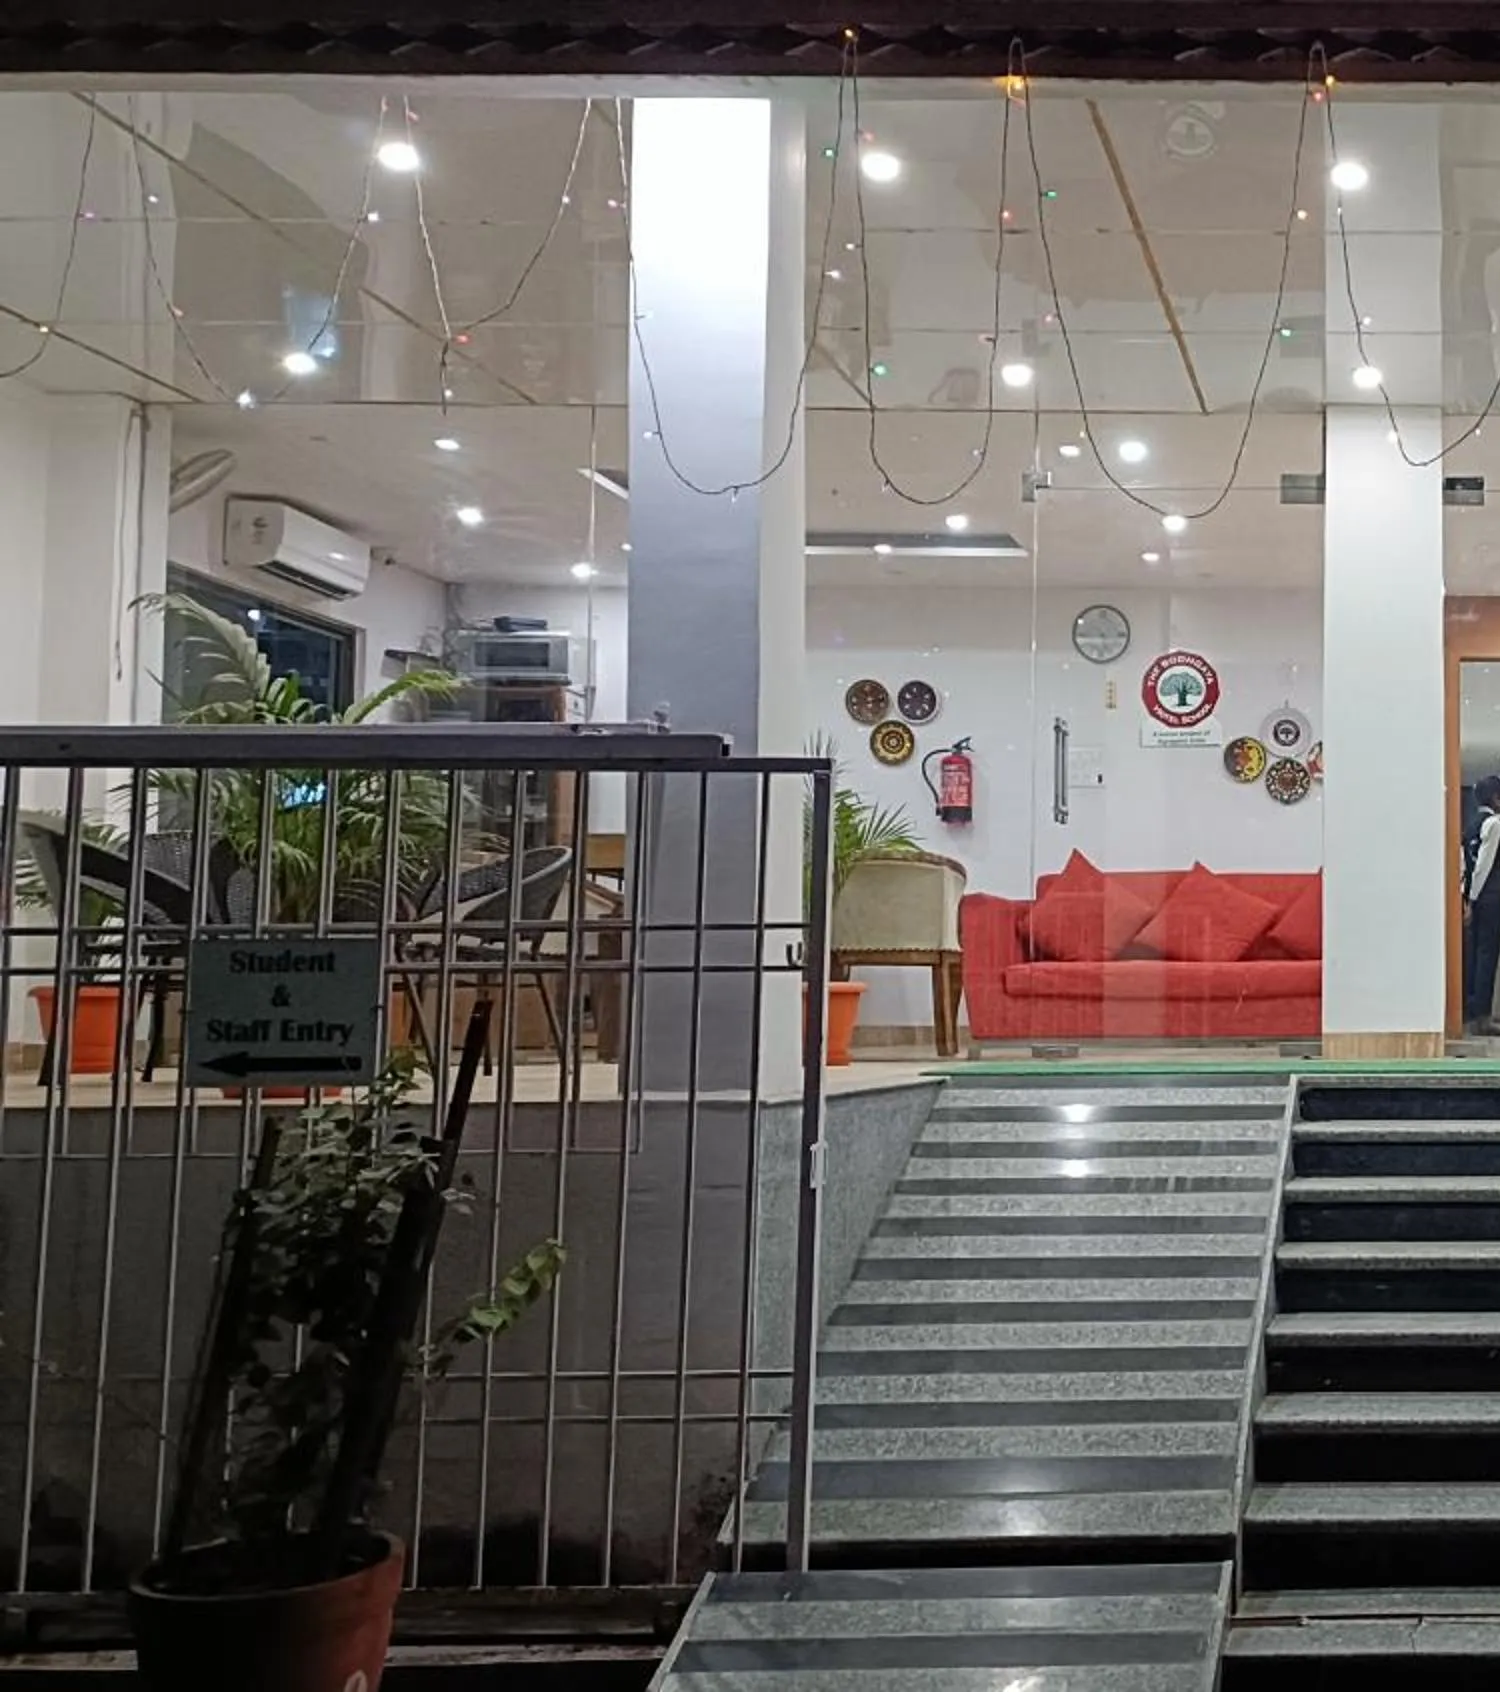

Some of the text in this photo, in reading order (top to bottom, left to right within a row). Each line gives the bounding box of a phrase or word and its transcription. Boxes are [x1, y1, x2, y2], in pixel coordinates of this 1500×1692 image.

[229, 949, 336, 974] Student
[271, 983, 291, 1008] &
[206, 1018, 354, 1047] Staff Entry
